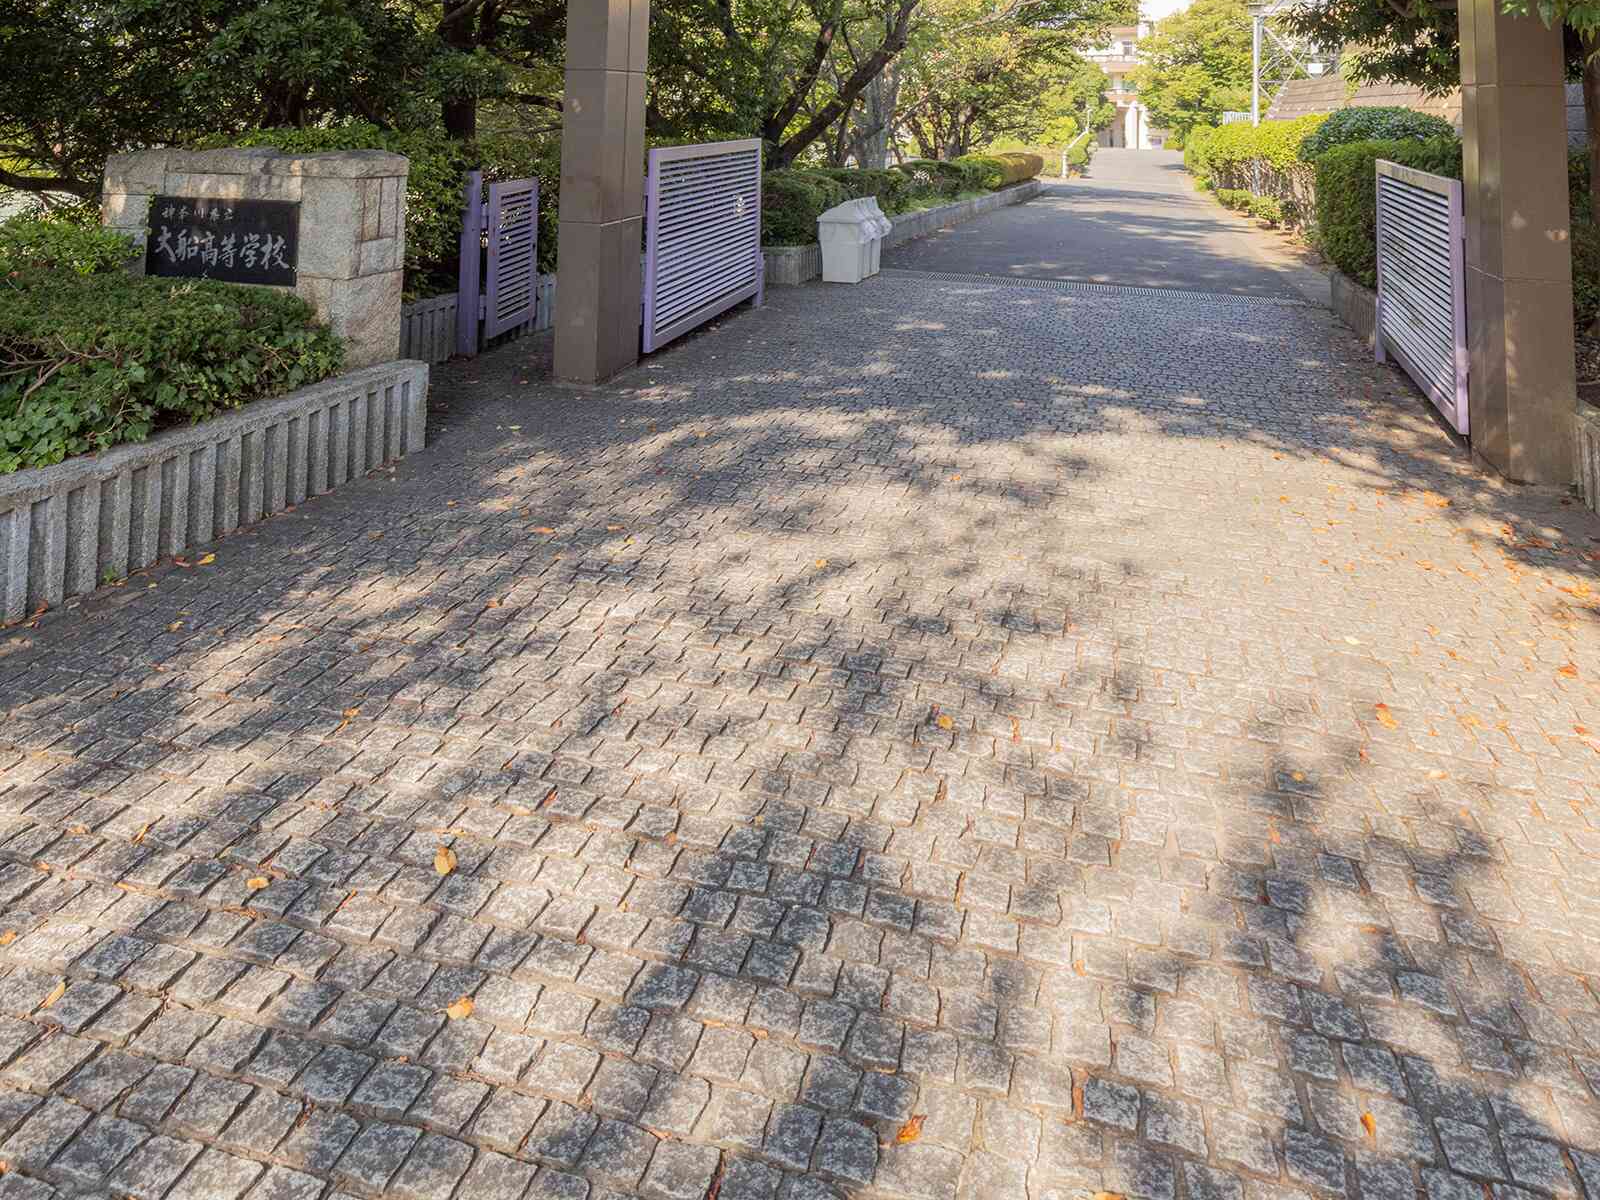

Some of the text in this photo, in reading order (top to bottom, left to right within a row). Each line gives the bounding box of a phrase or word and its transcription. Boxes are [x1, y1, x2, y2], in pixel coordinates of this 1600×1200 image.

[155, 225, 290, 271] 大船高等学校
